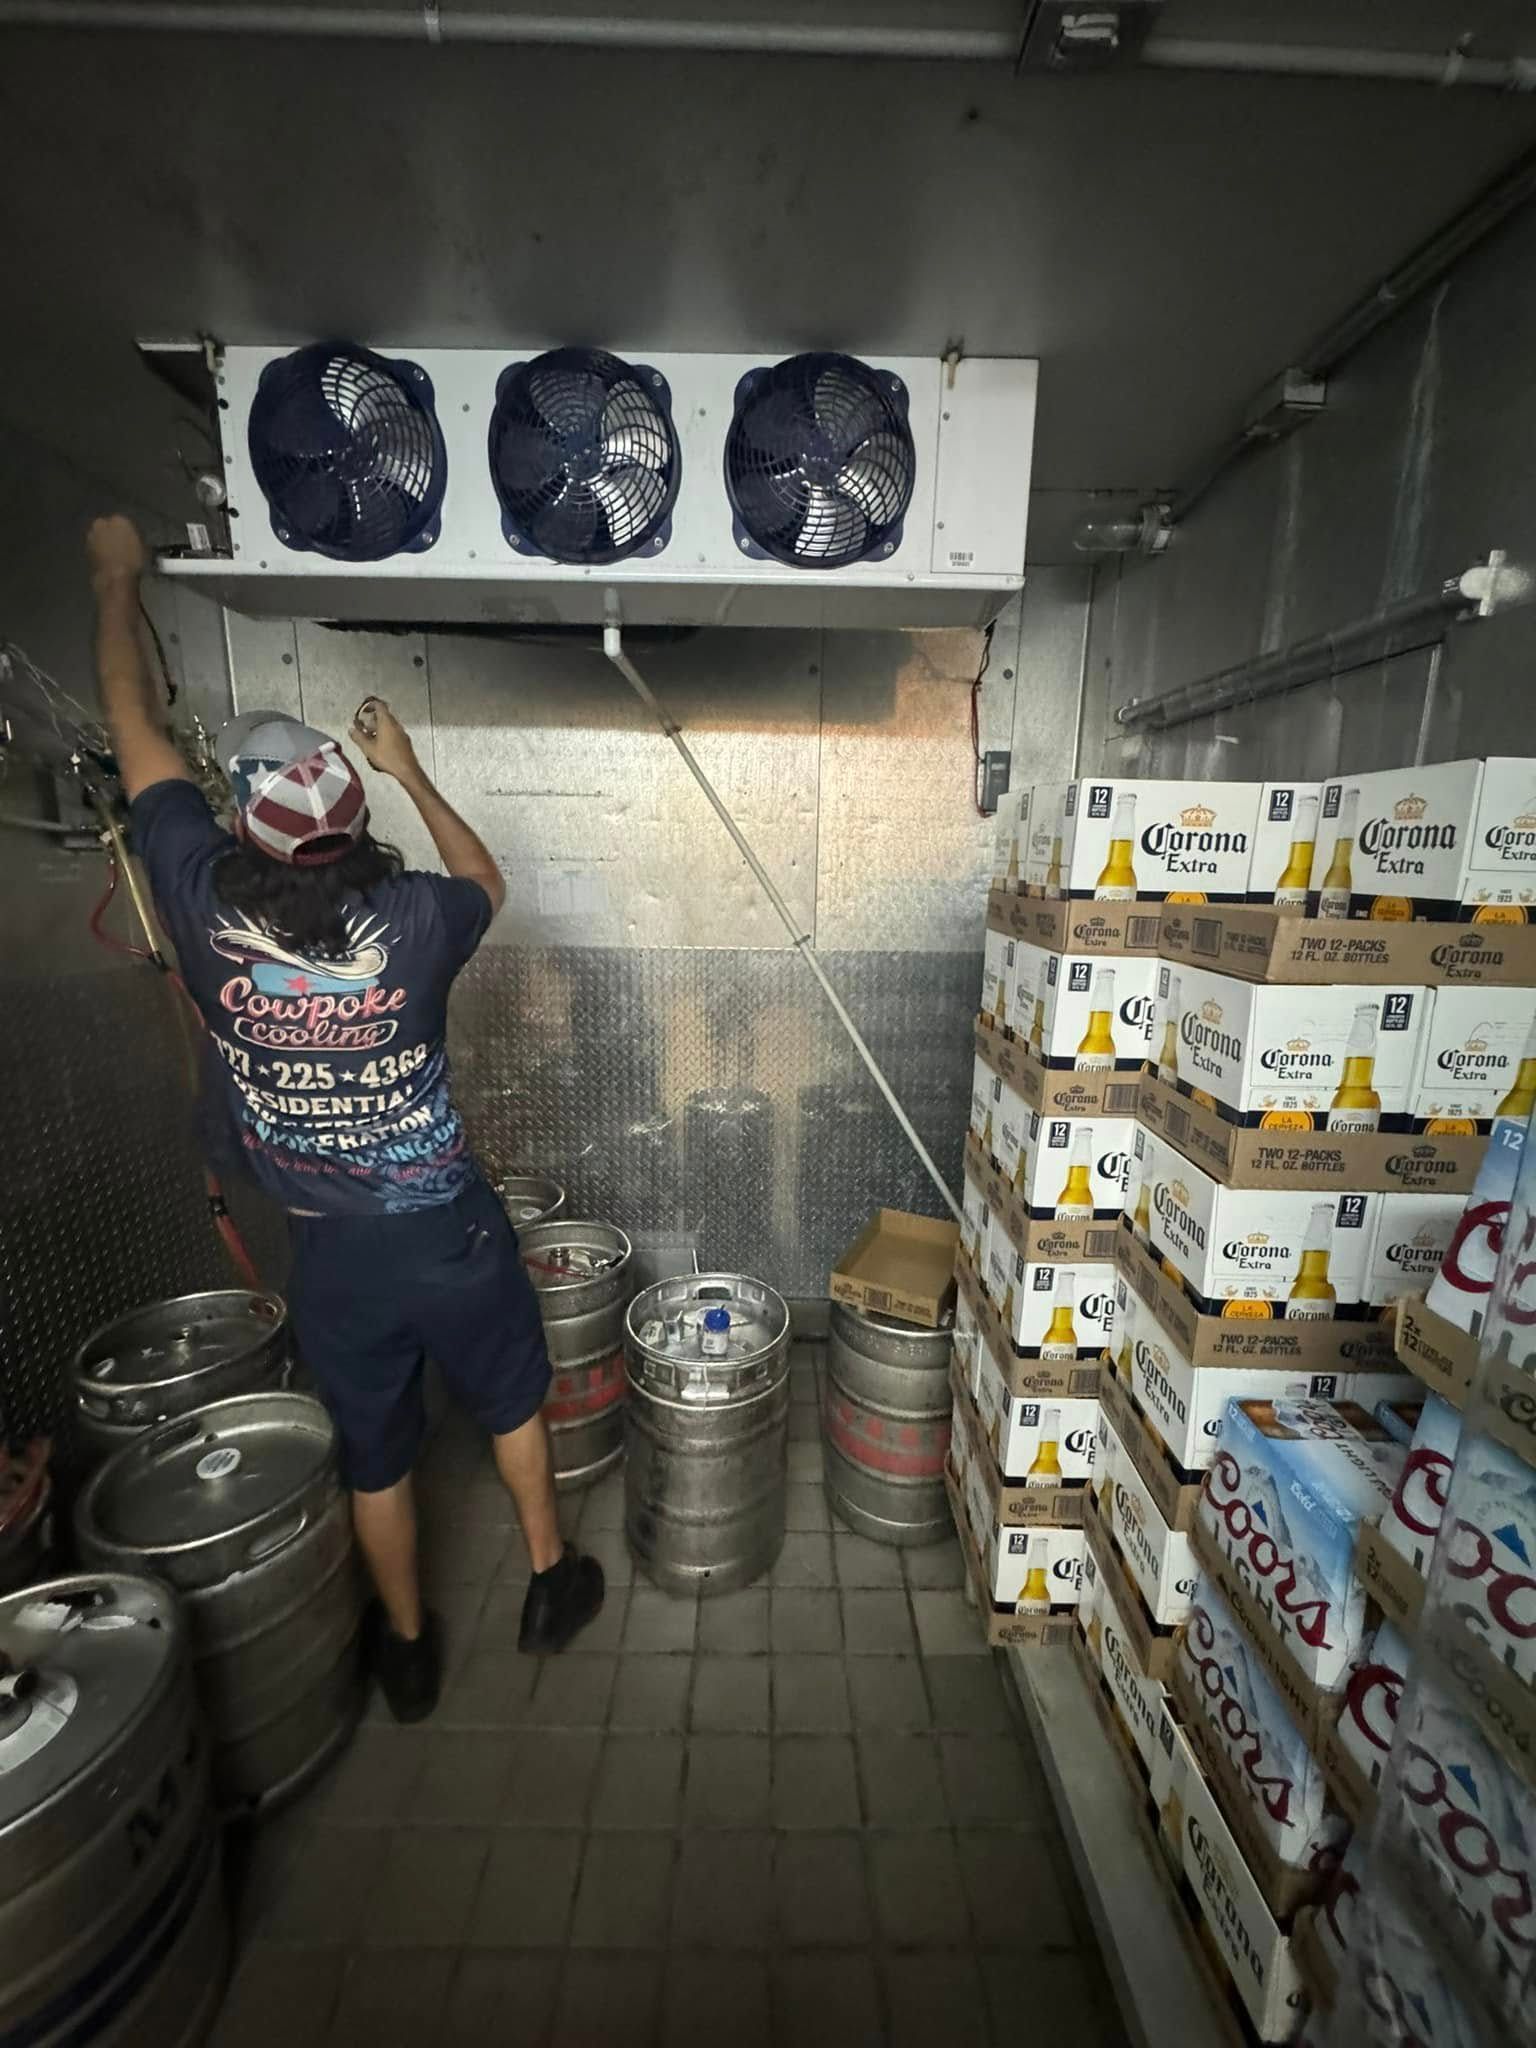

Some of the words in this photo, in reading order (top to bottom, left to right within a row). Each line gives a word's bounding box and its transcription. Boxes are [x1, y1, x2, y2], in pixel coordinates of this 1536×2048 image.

[1094, 788, 1108, 804] 12
[1274, 791, 1289, 807] 12
[1329, 787, 1337, 803] 12
[1141, 822, 1247, 859] Corona
[1359, 818, 1456, 859] Corona
[1485, 825, 1536, 851] Coro
[1166, 854, 1217, 874] Extra
[1376, 852, 1424, 875] Extra
[1073, 923, 1120, 938] Corona
[1301, 937, 1326, 950] TWO
[1330, 938, 1386, 951] 12-PACKS
[1291, 950, 1303, 960] 12
[1343, 952, 1389, 963] BOTTLES
[1431, 943, 1503, 966] Corona
[1074, 965, 1087, 978] 12
[1446, 965, 1481, 978] Extra
[220, 976, 407, 1031] Cowpoke
[1390, 996, 1406, 1013] 12
[251, 1019, 387, 1048] cooling
[1181, 1011, 1242, 1062] Corona
[1192, 1046, 1222, 1079] Extra
[1261, 1049, 1332, 1071] Corona
[1438, 1049, 1507, 1071] Corona
[272, 1061, 336, 1090] 225
[1278, 1068, 1312, 1080] Extra
[1453, 1068, 1487, 1080] Extra
[1054, 1093, 1097, 1106] Corona
[1053, 1124, 1066, 1136] 12
[1503, 1129, 1524, 1150] 12
[1258, 1148, 1283, 1160] TWO
[1288, 1149, 1342, 1161] 12-PACKS
[1386, 1154, 1457, 1175] Corona
[1251, 1160, 1261, 1168] 12
[1301, 1161, 1345, 1172] BOTTLES
[1402, 1173, 1436, 1185] Extra
[1344, 1197, 1360, 1213] 12
[1154, 1181, 1205, 1250] Corona
[1037, 1237, 1080, 1251] Corona
[1163, 1219, 1189, 1258] Extra
[1223, 1241, 1290, 1262] Corona
[1386, 1243, 1444, 1263] Coron
[1039, 1268, 1050, 1280] 12
[1239, 1258, 1271, 1270] Extra
[1401, 1260, 1435, 1273] Extra
[1220, 1333, 1244, 1344] TWO
[1136, 1340, 1186, 1424] Corona
[1317, 1378, 1331, 1392] 12
[1145, 1376, 1170, 1425] Extra
[1025, 1406, 1036, 1416] 12
[1014, 1535, 1025, 1545] 12
[1116, 1483, 1159, 1581] Corona
[1204, 1450, 1334, 1651] Coors
[1392, 1448, 1536, 1641] Coo
[1105, 1625, 1156, 1738] Corona
[1185, 1605, 1296, 1828] Coors
[1347, 1663, 1536, 1949] Coor
[1187, 1814, 1264, 1988] Corona
